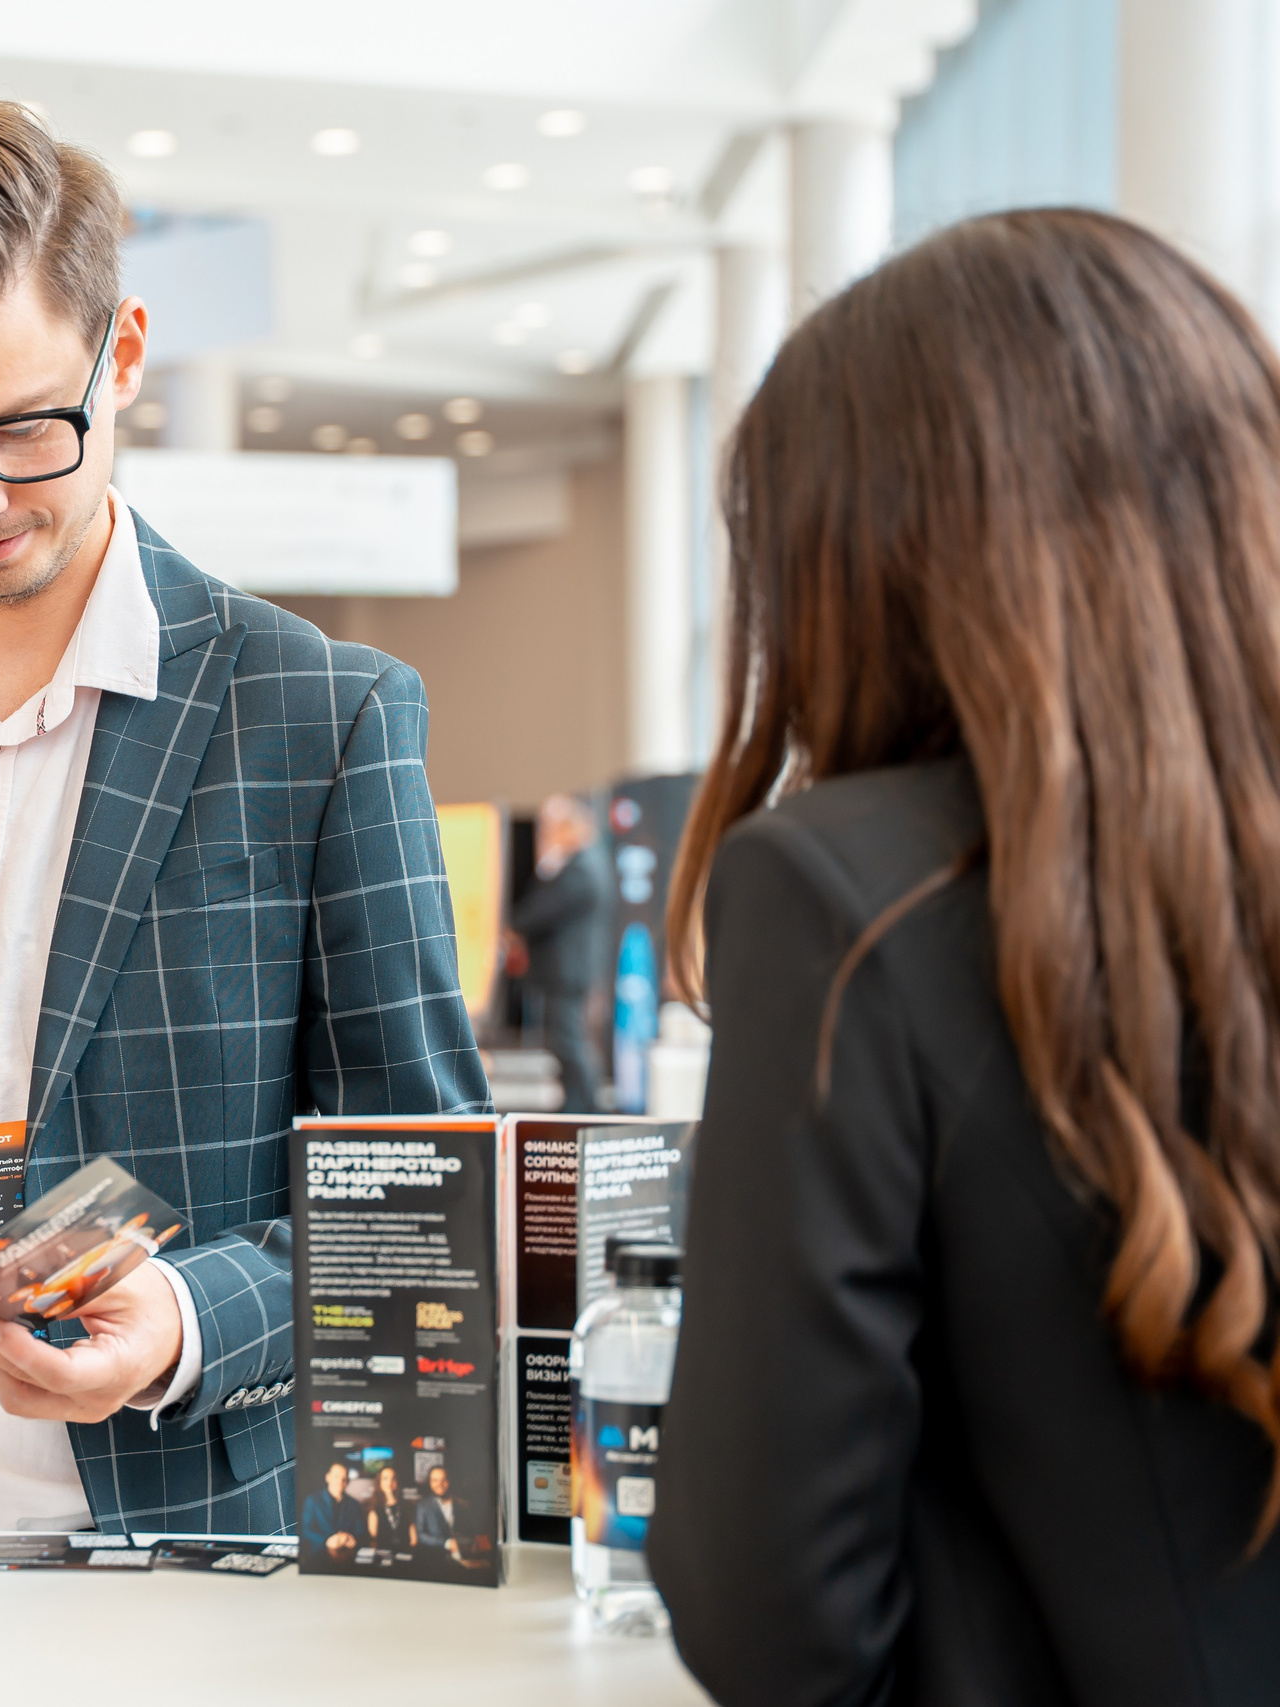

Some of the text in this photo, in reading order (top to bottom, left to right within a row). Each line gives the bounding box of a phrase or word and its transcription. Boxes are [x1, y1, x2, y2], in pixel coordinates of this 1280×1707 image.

[307, 1156, 462, 1172] ПАРТНЕРСТВО
[307, 1185, 386, 1200] РЫНКА
[526, 1368, 562, 1382] ВИЗЫ
